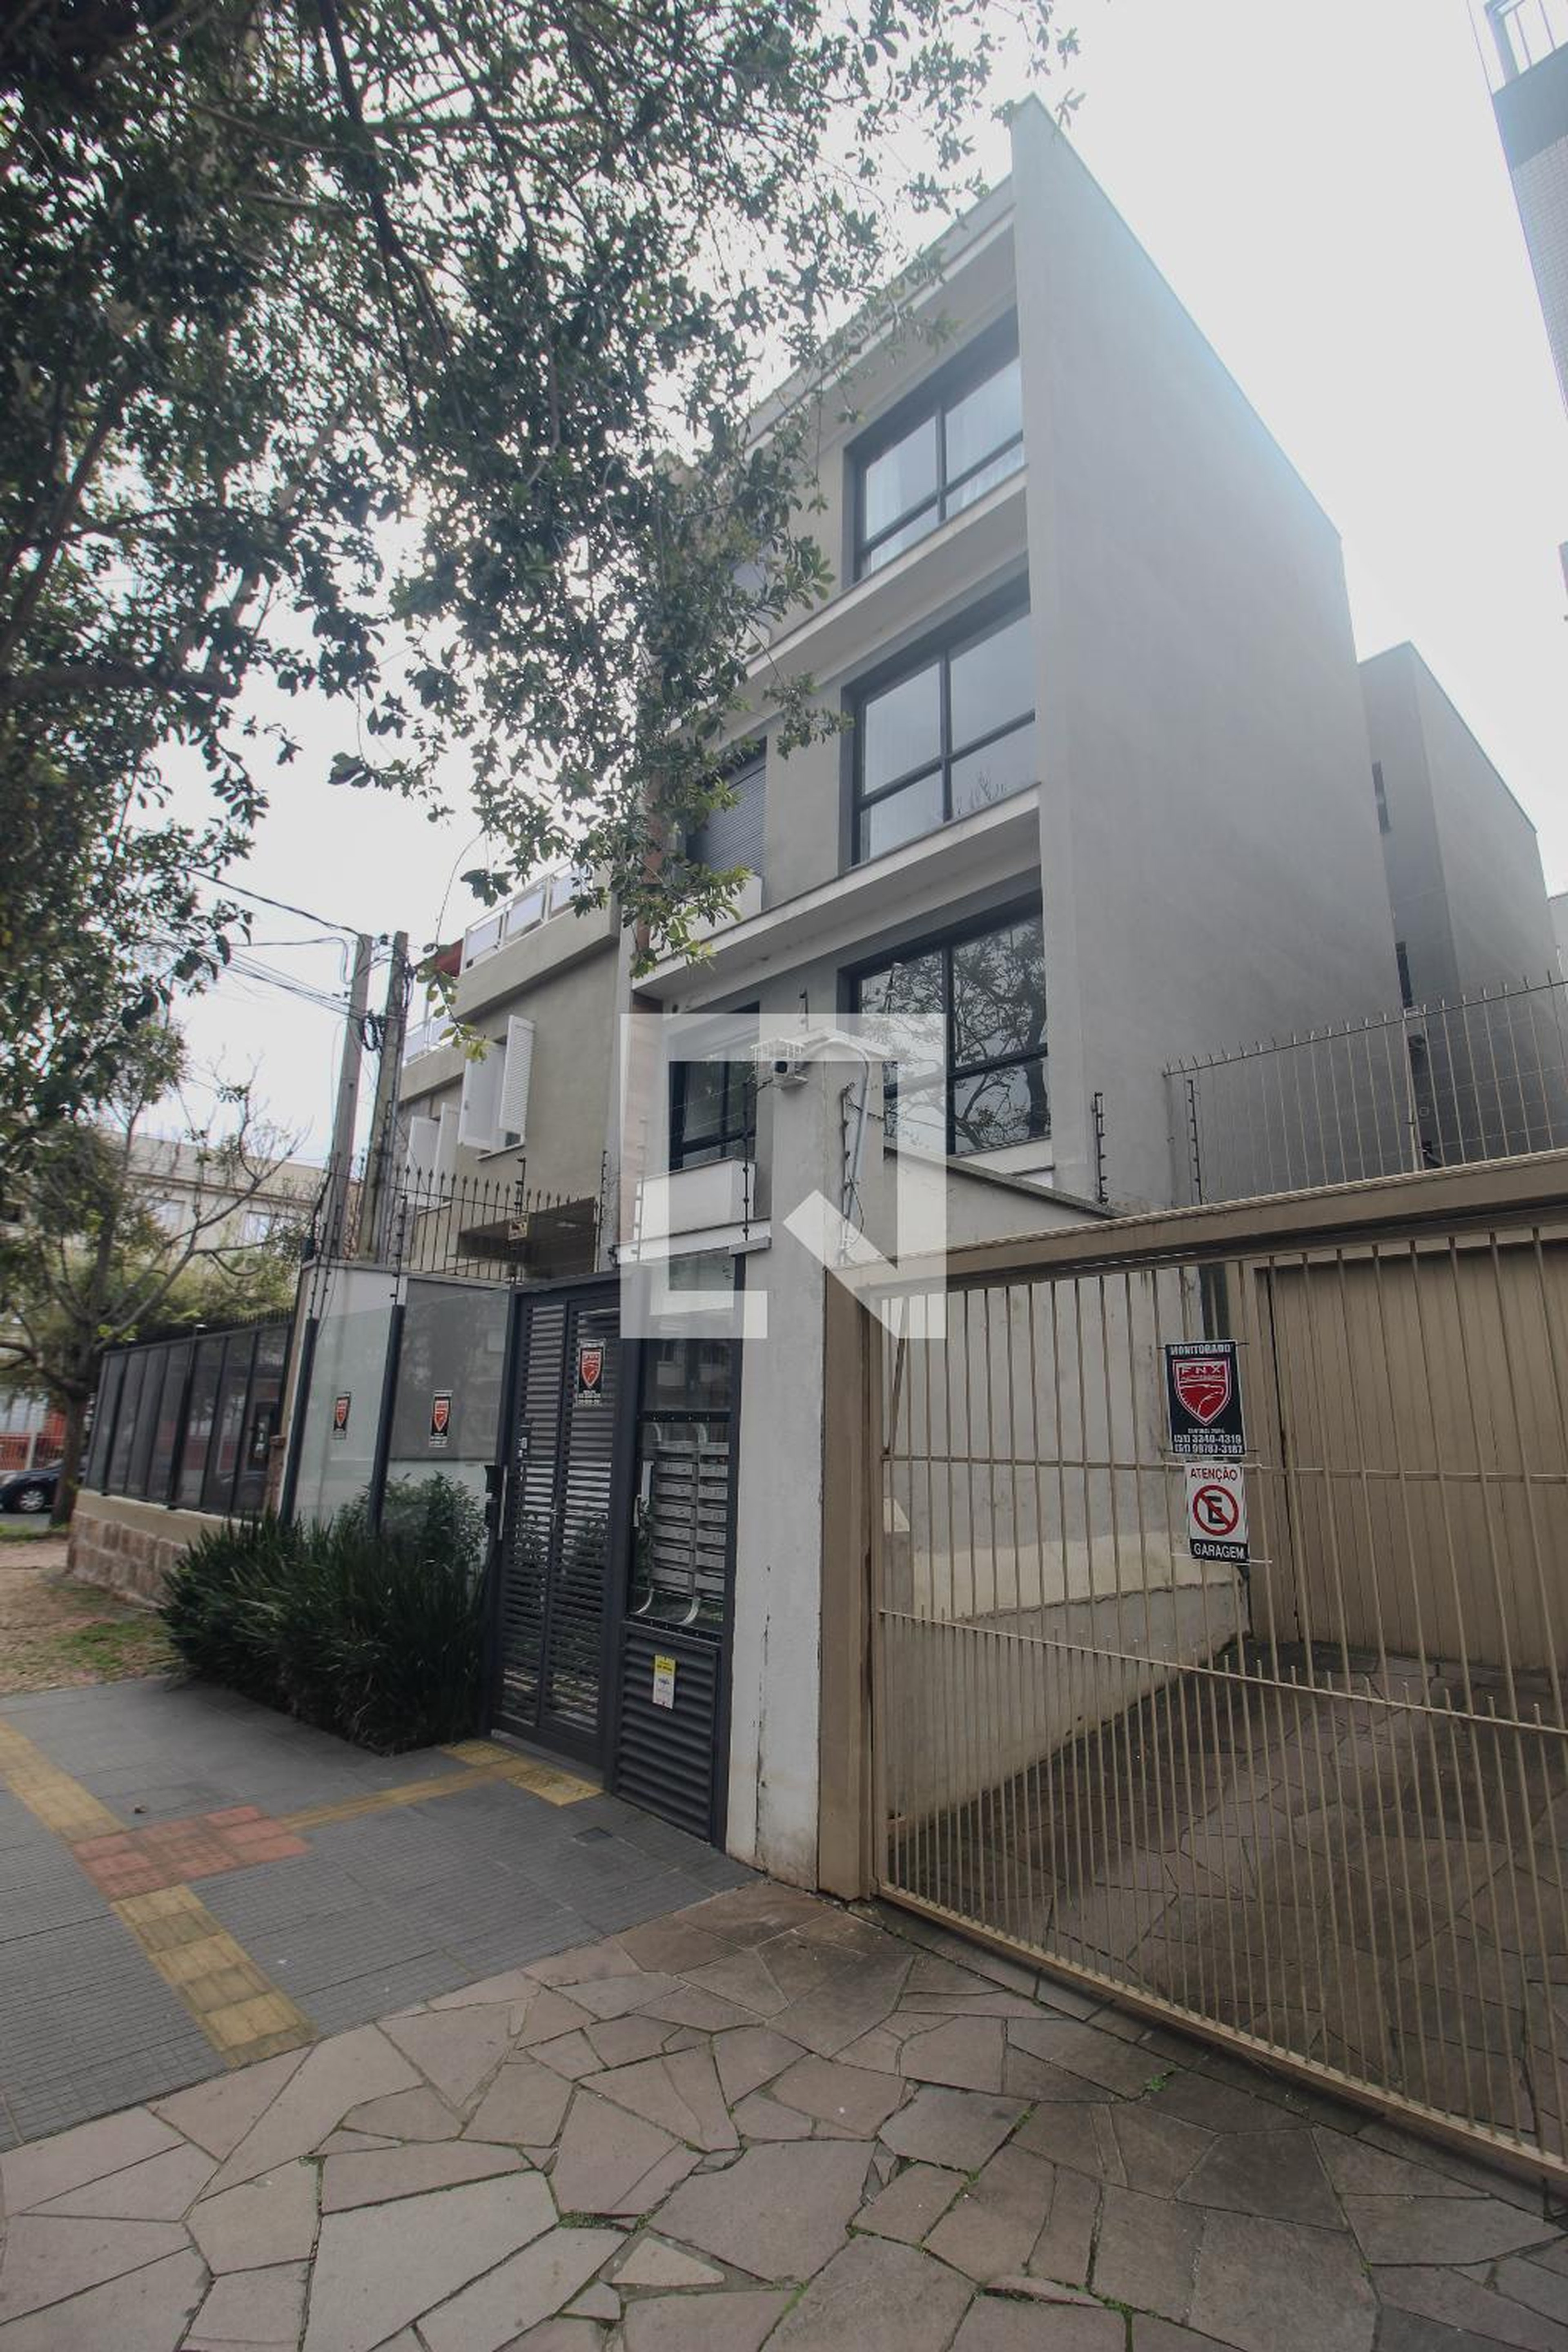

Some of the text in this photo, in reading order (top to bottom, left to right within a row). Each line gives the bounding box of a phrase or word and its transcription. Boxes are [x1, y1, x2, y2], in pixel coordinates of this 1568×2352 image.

[1170, 1343, 1231, 1355] MONITORADO
[1191, 1466, 1238, 1482] ATENÇÃO
[1194, 1543, 1245, 1559] GARAGEM
